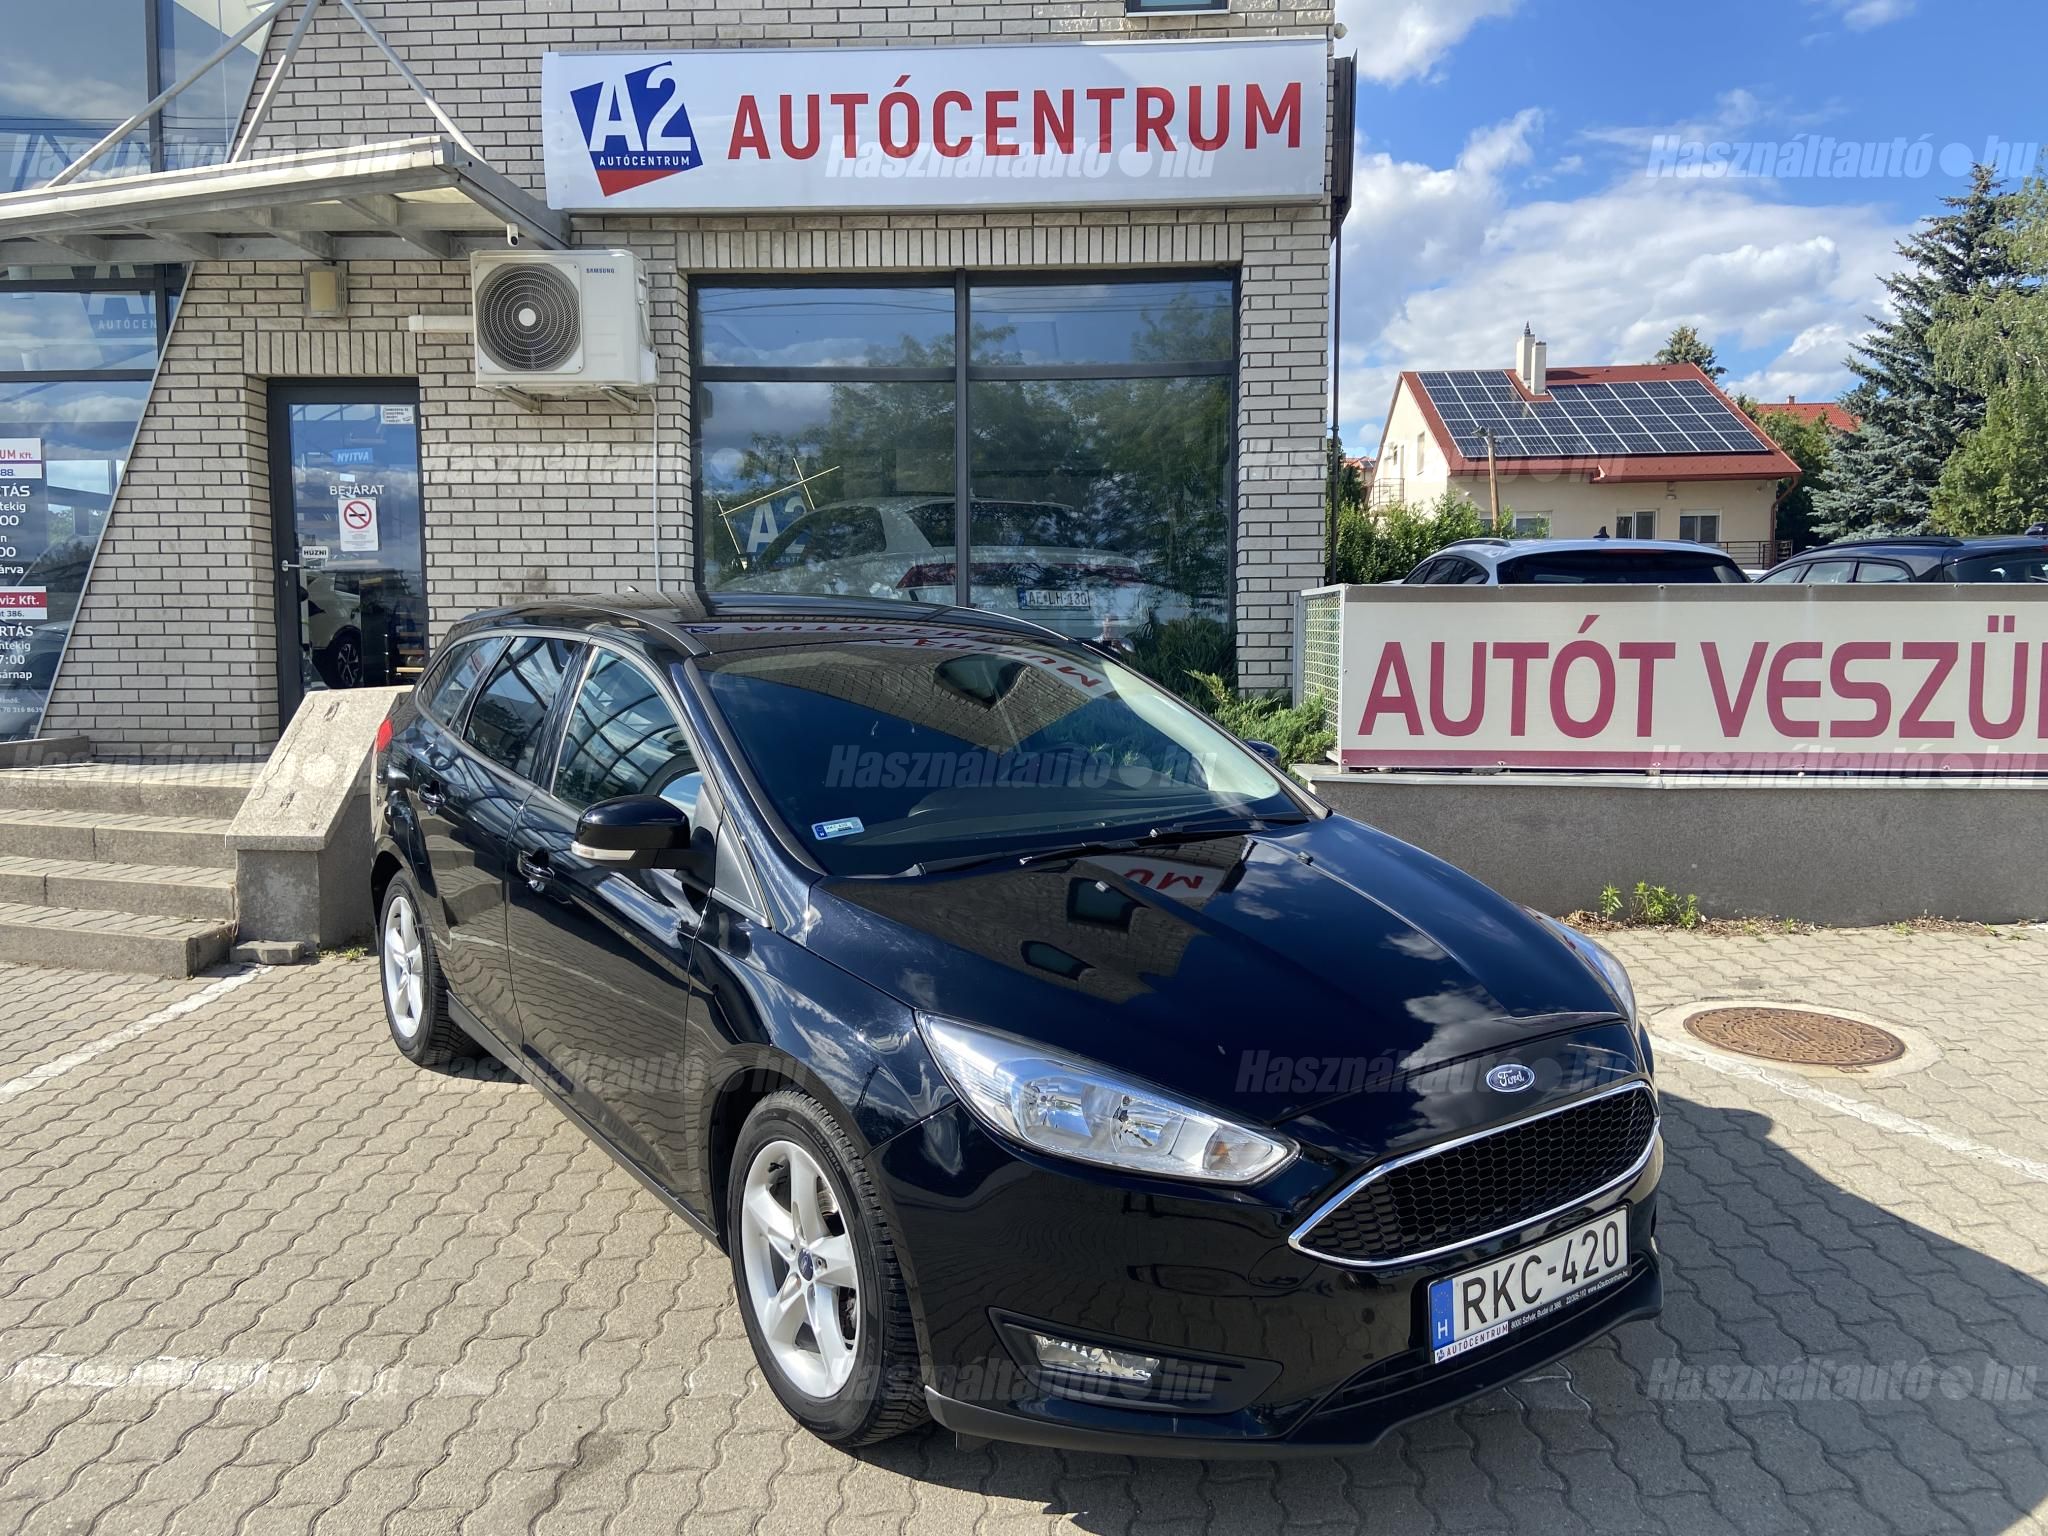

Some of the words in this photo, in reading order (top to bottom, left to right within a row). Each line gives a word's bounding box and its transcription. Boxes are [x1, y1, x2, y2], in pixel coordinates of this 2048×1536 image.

[589, 65, 691, 151] A2
[727, 75, 1302, 160] AUTÓCENTRUM
[600, 154, 690, 166] AUTÓCENTRUM
[337, 452, 369, 462] NYITVA
[0, 482, 30, 497] TÁS
[330, 483, 384, 495] BEJÁRAT
[19, 595, 40, 604] Kft.
[0, 670, 33, 681] árnap
[1357, 615, 1676, 738] AUTÓT
[1700, 615, 2048, 739] VESZÜ
[1498, 1069, 1524, 1087] Ford
[1462, 1220, 1619, 1331] RKC-420
[1438, 1318, 1448, 1340] H
